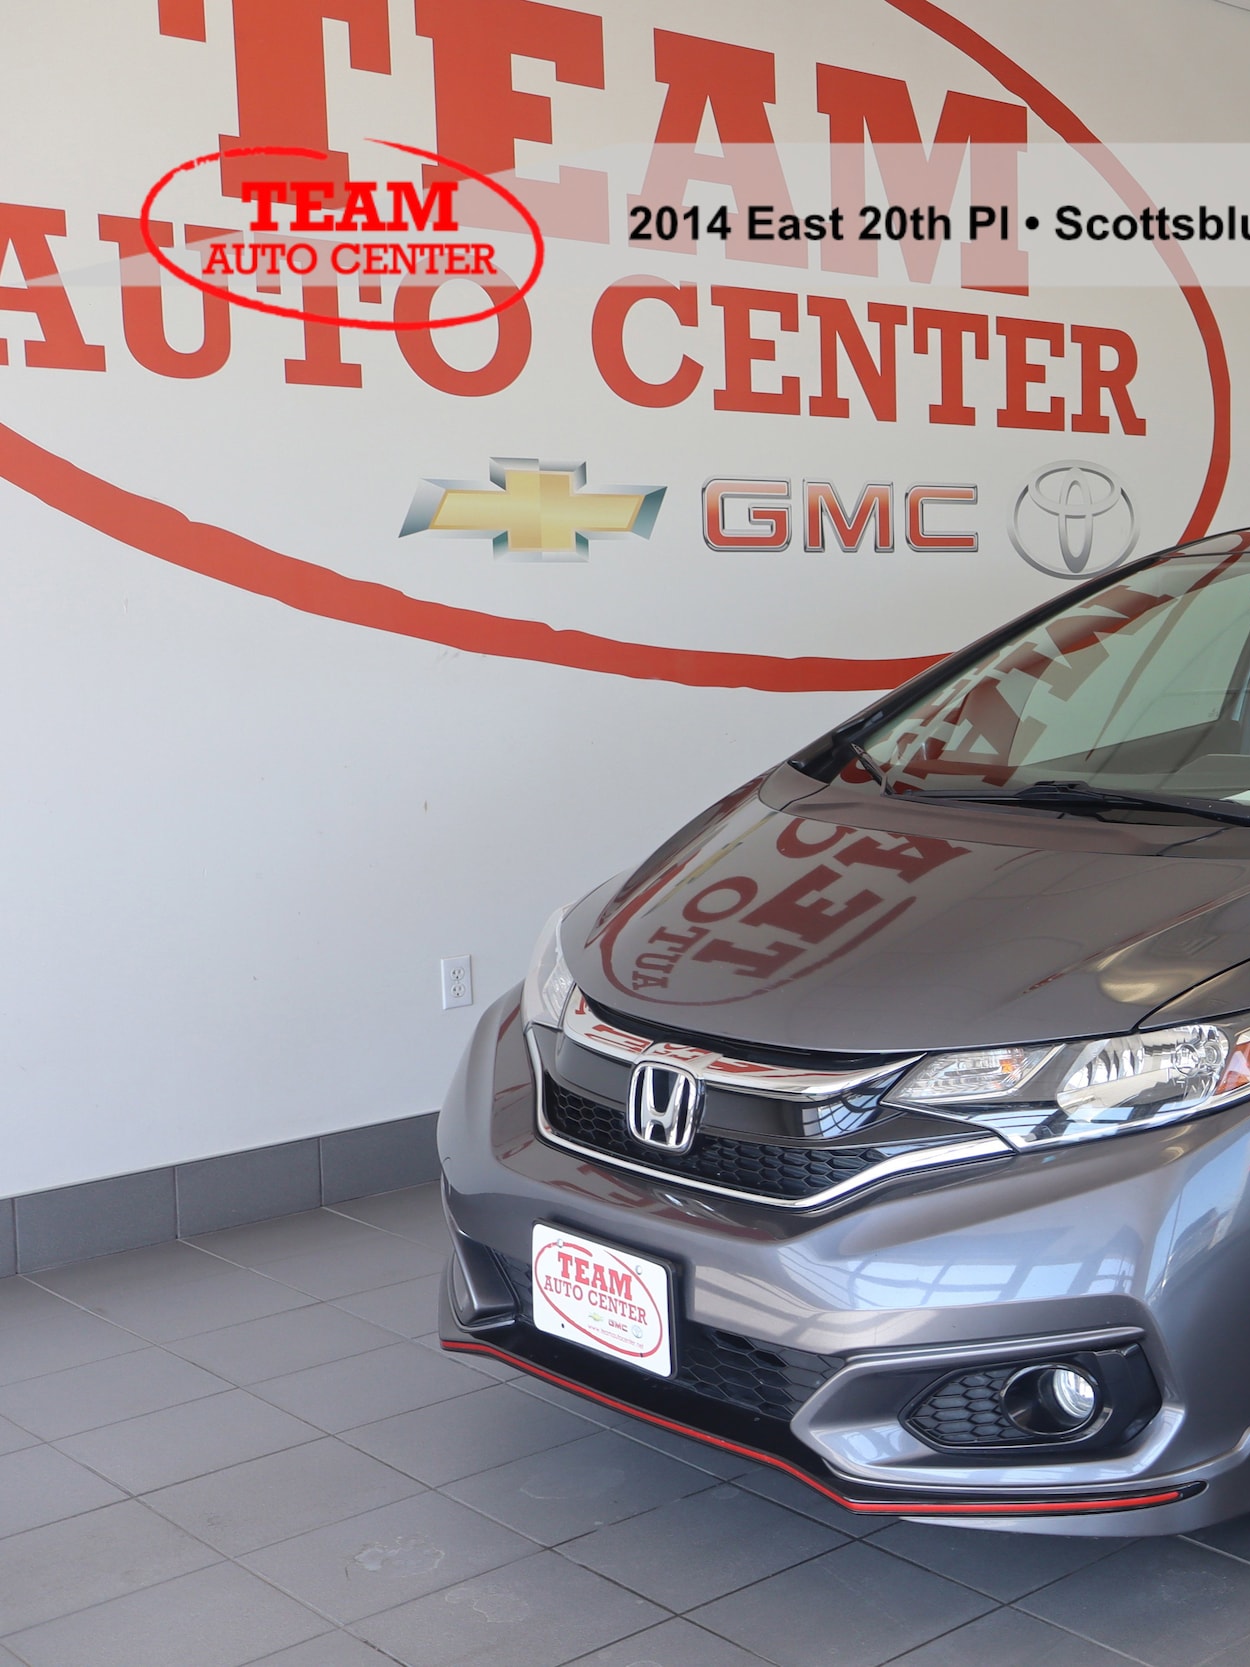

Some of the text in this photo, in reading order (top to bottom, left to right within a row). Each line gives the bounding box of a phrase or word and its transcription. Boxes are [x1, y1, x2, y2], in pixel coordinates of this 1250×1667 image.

[158, 0, 1030, 297] TEAM
[0, 203, 1147, 436] AUTO CENTER
[701, 477, 979, 555] GMC
[544, 1275, 648, 1326] AUTO CENTER
[557, 1251, 633, 1301] TEAM
[608, 1319, 628, 1333] GMC
